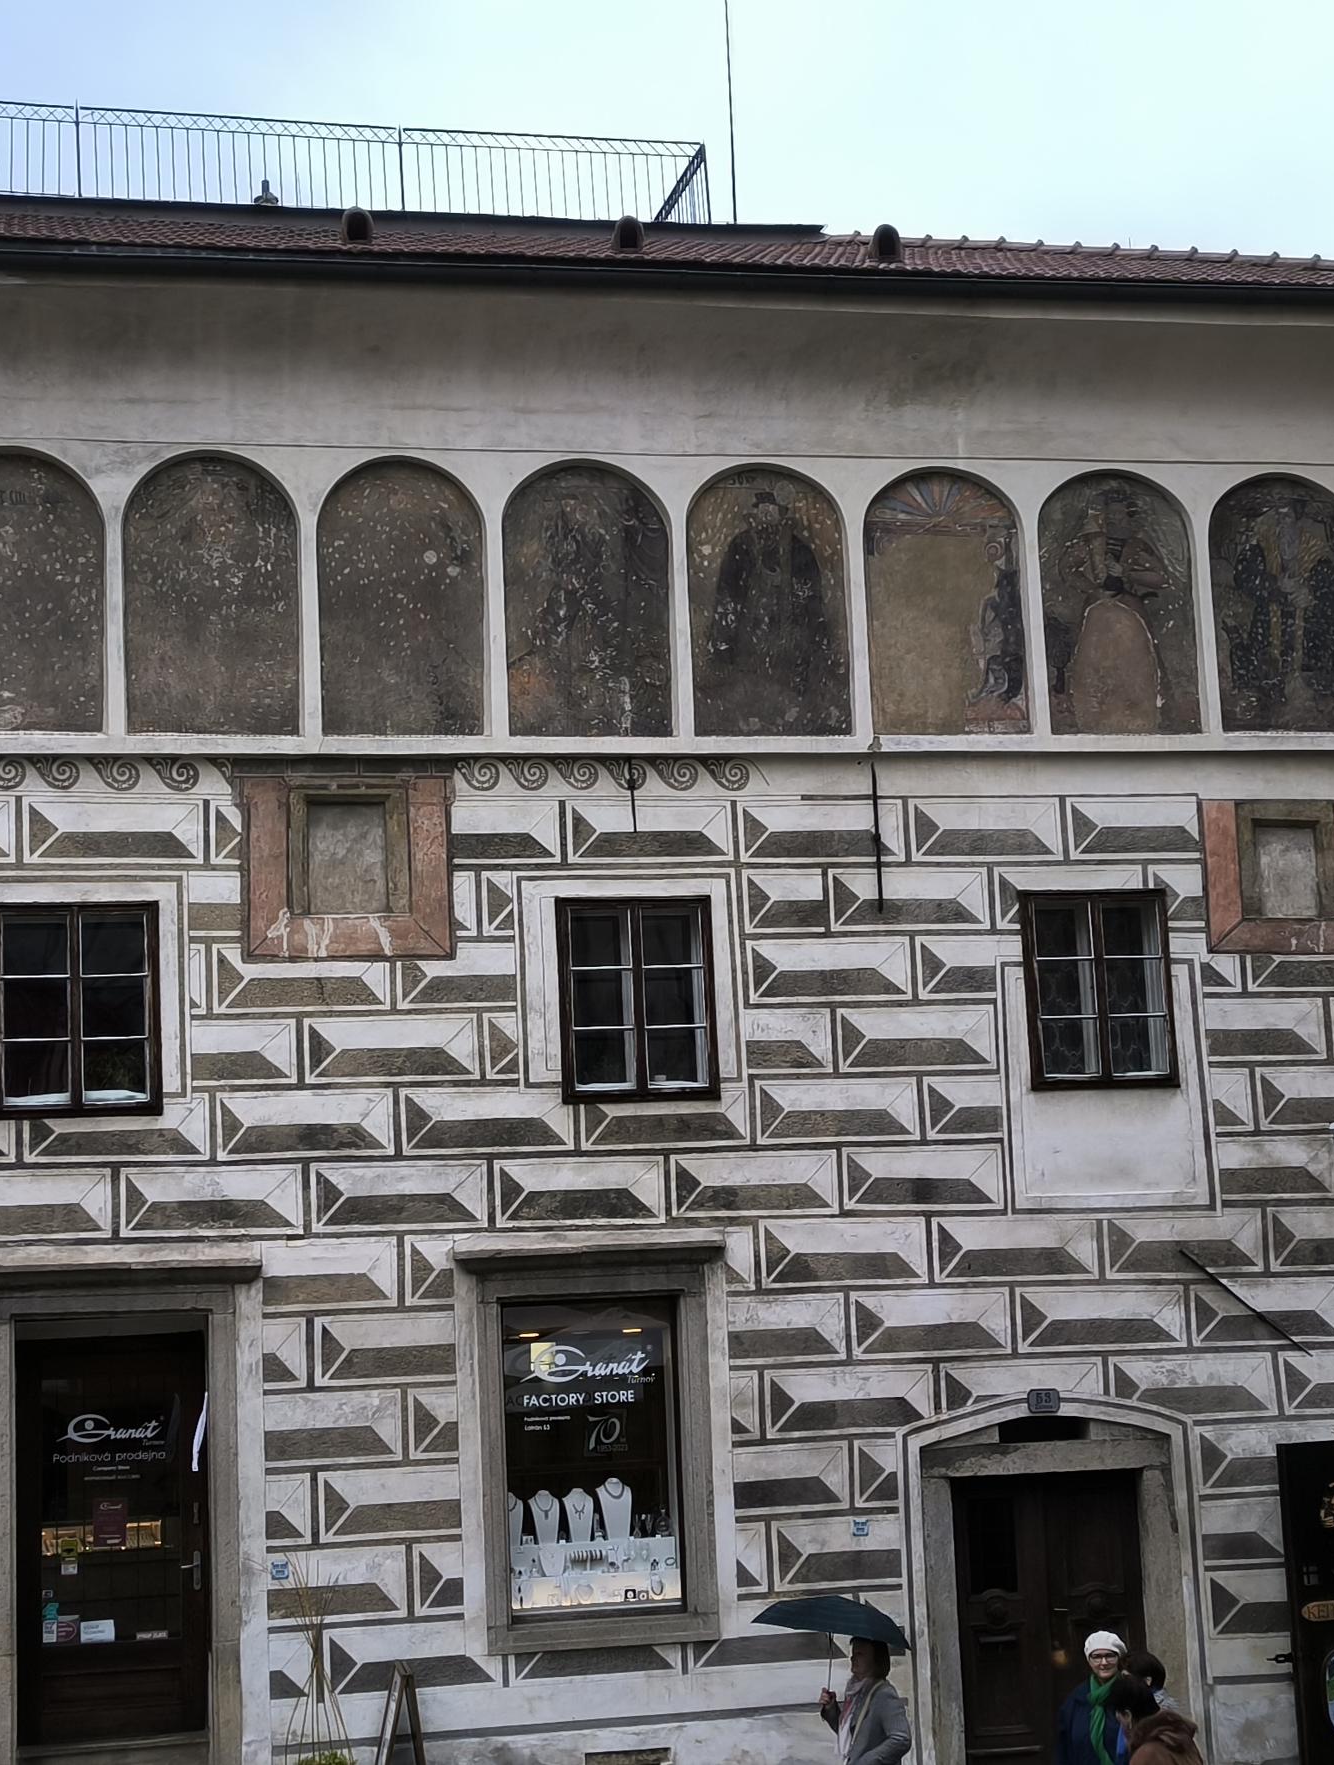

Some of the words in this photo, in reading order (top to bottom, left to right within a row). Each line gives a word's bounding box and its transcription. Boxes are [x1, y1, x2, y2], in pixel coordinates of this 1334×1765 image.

[520, 1345, 650, 1383] Granát
[523, 1393, 586, 1407] FACTORY
[594, 1390, 635, 1404] STORE
[56, 1413, 163, 1444] Granát
[52, 1452, 111, 1463] Podniková
[115, 1449, 167, 1462] prodejna
